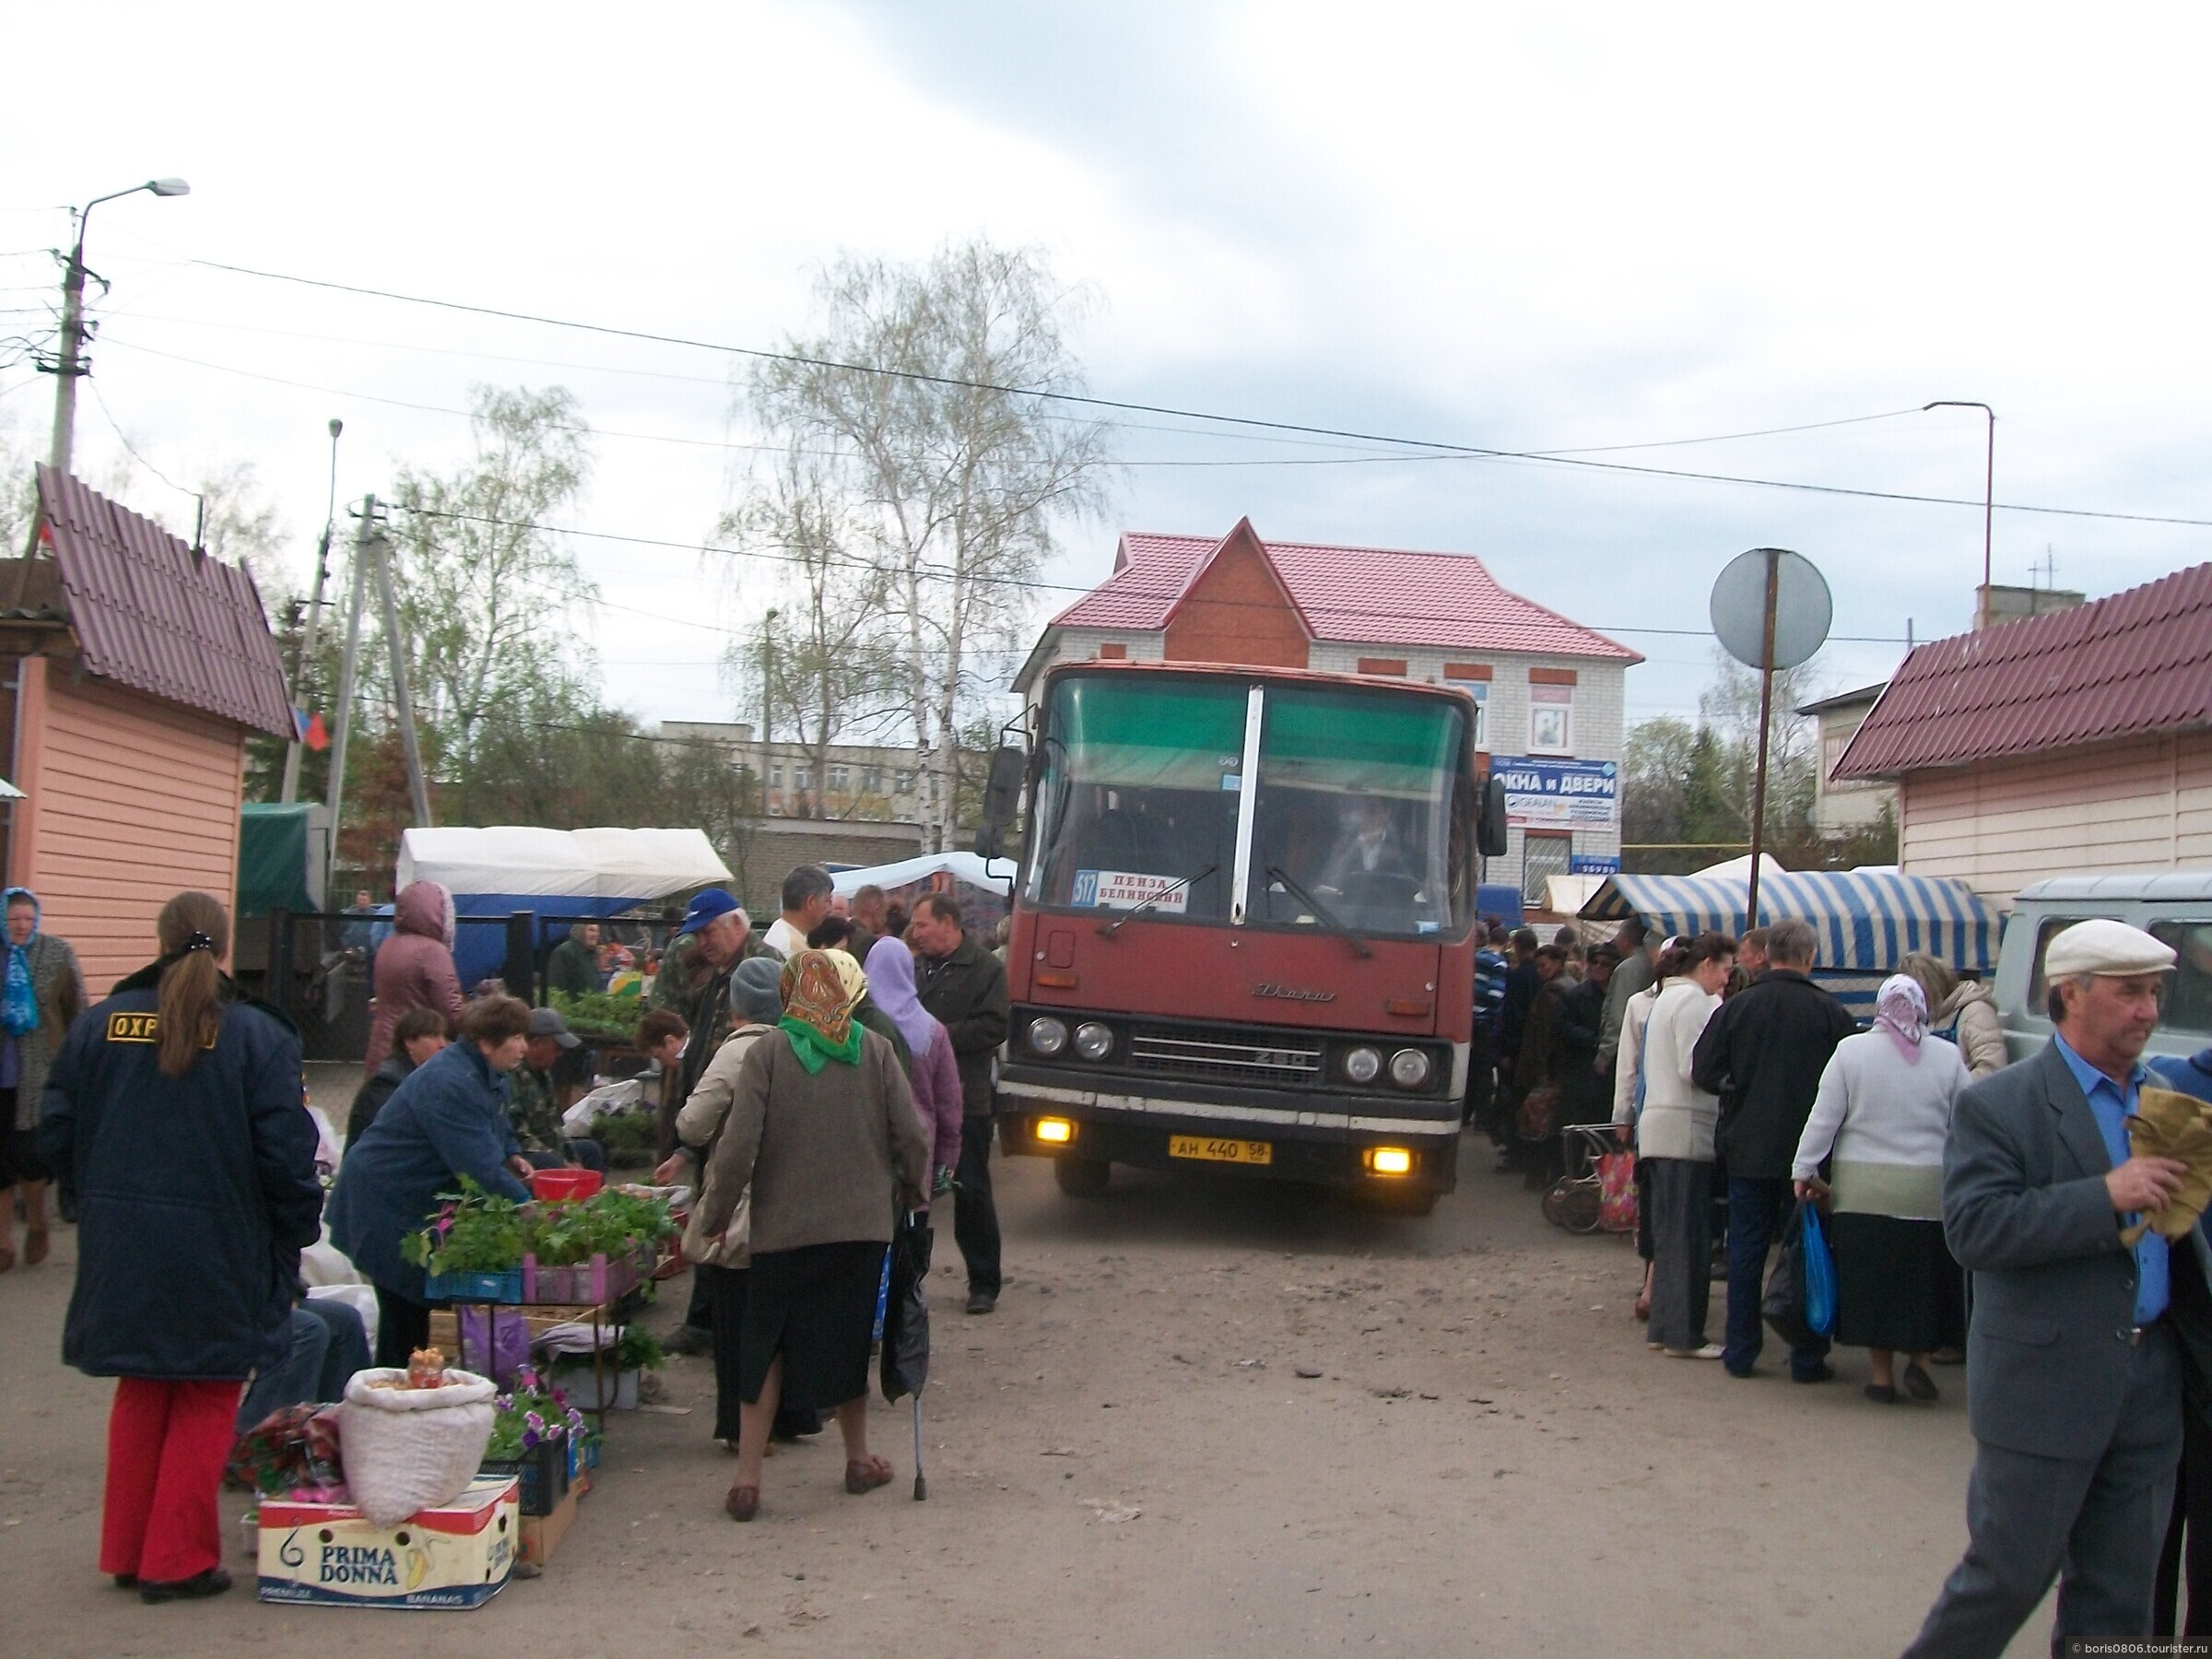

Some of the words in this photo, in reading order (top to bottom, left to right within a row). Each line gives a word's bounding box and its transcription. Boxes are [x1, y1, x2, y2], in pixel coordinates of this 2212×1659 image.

[1559, 774, 1614, 794] ДВЕРИ
[1113, 875, 1166, 889] ПЕНЗА
[1178, 1142, 1198, 1156] АН
[1206, 1141, 1239, 1159] 440
[1249, 1143, 1265, 1157] 58
[322, 1546, 396, 1566] PRIMA
[320, 1565, 399, 1585] DONNA
[406, 1594, 464, 1605] BANANAS
